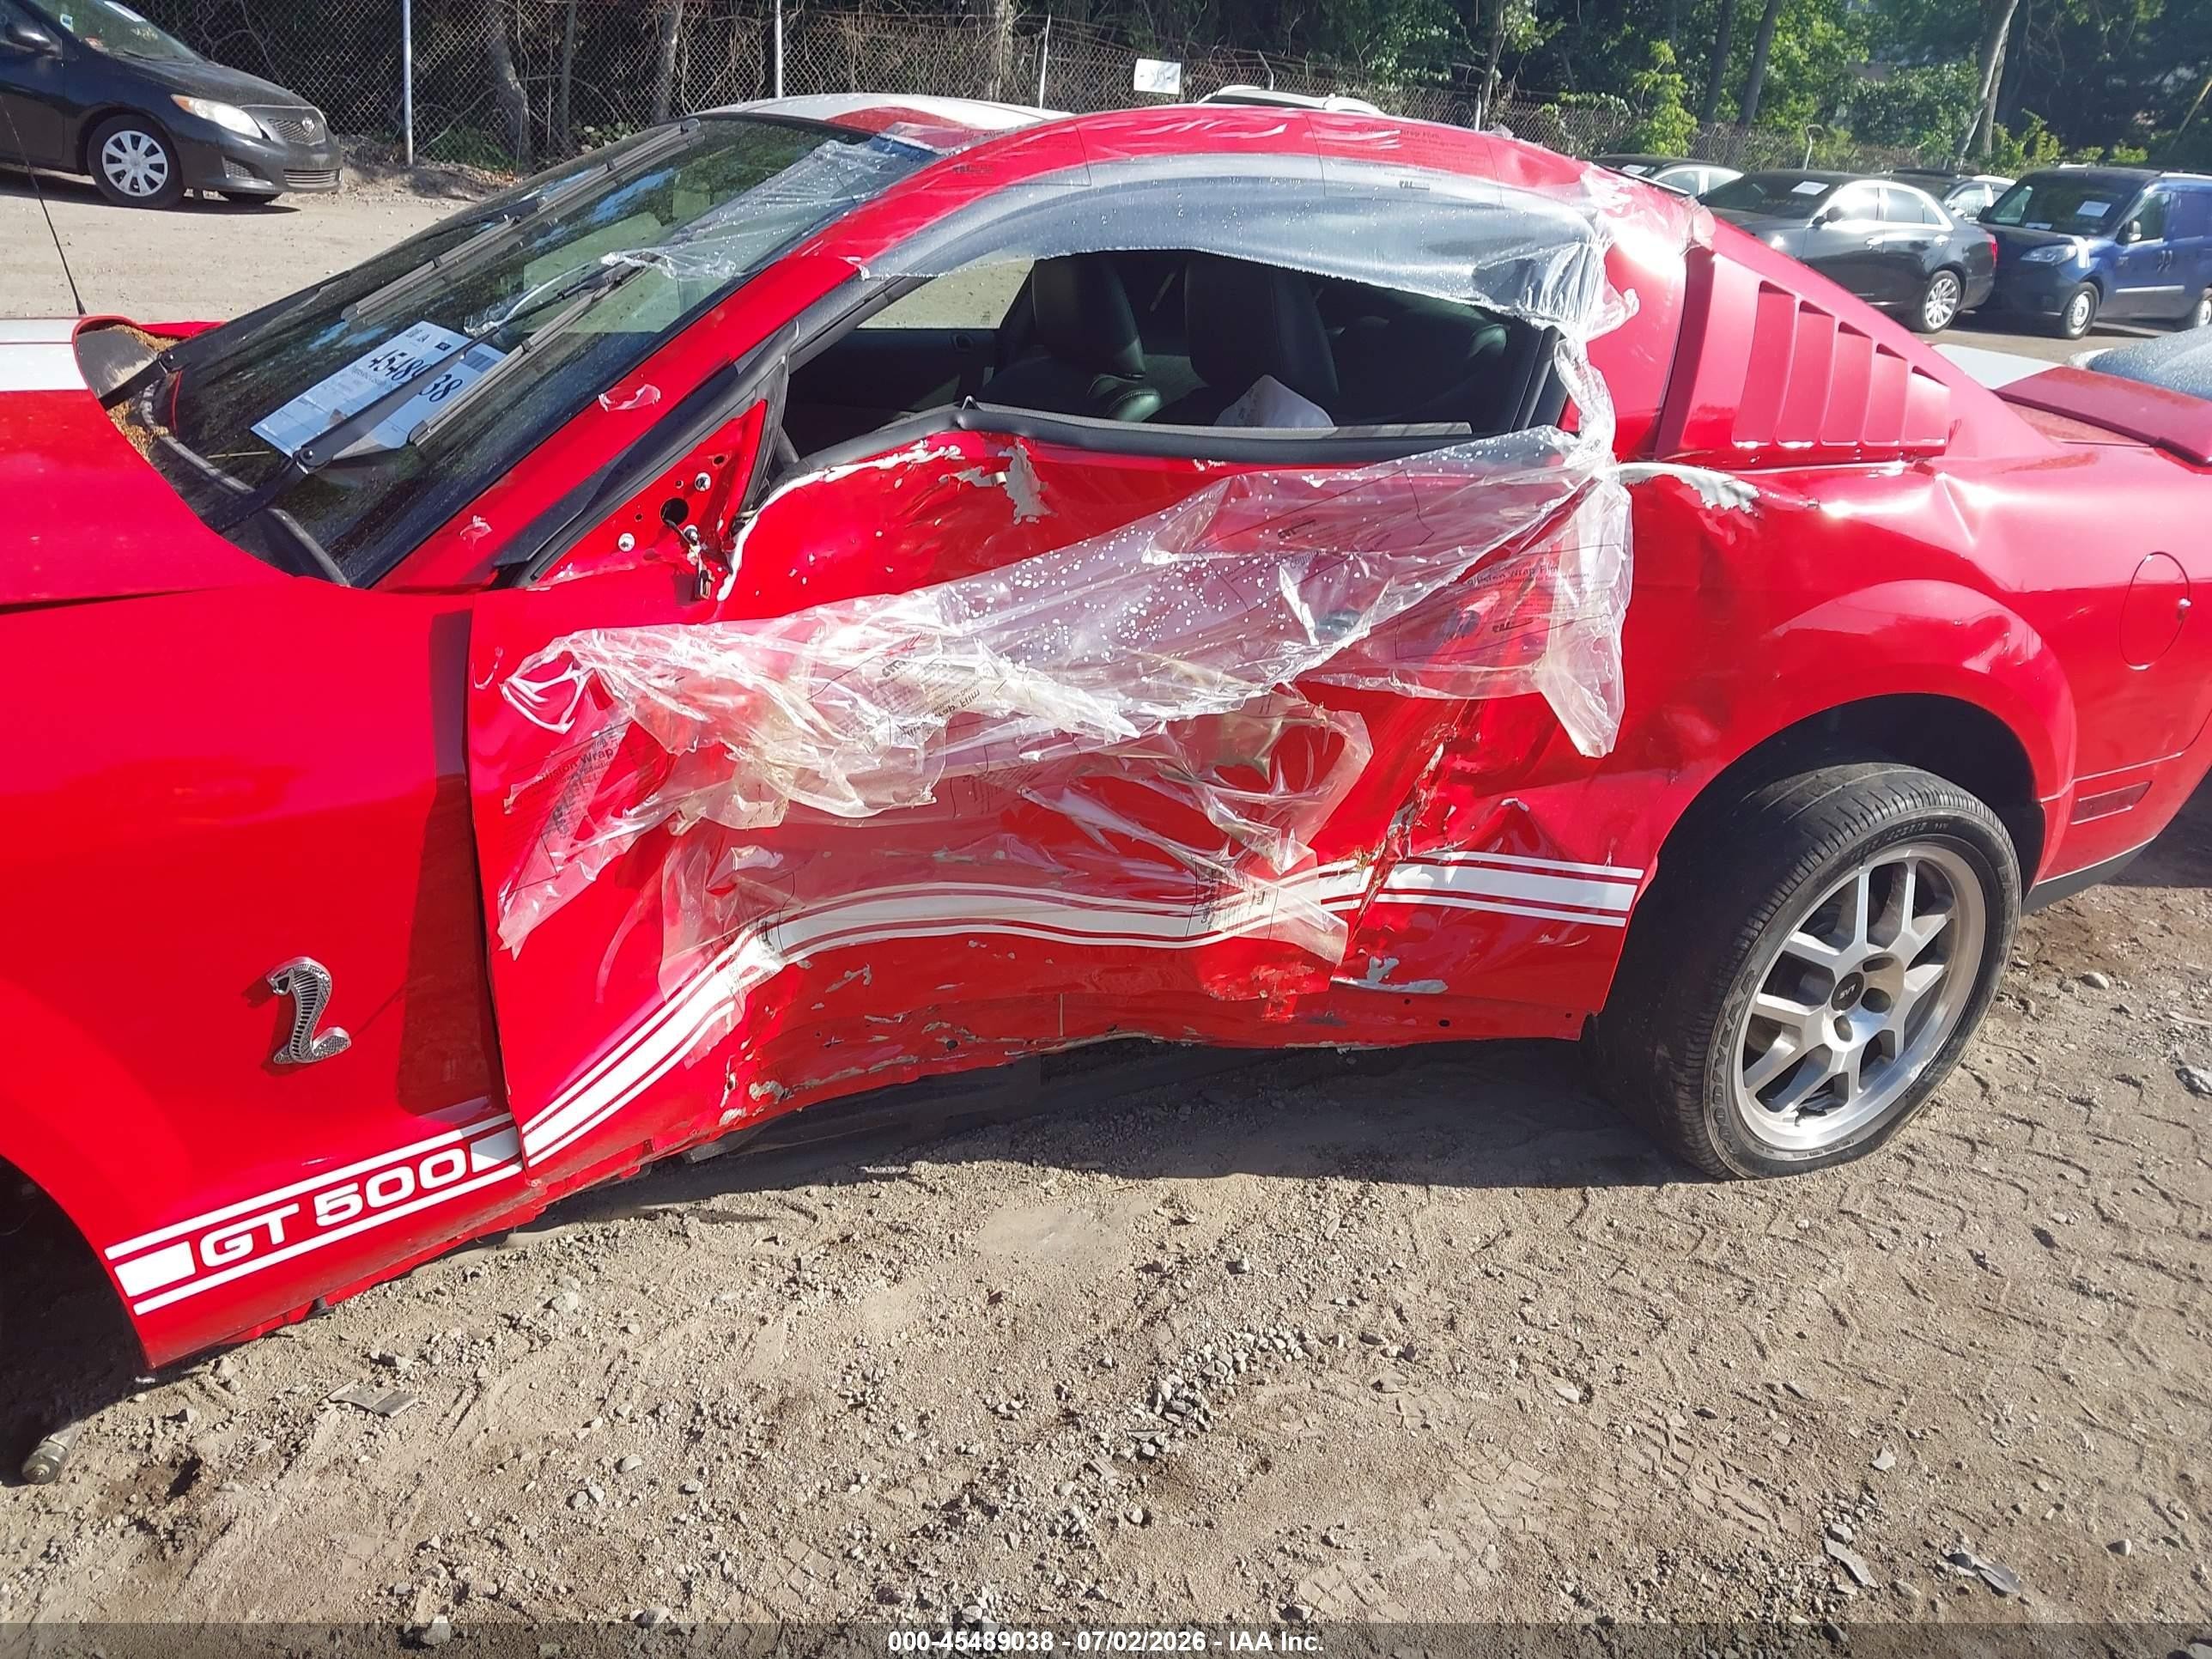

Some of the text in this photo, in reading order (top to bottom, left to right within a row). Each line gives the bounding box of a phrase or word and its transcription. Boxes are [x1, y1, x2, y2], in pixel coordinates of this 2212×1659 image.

[368, 349, 464, 403] 454838
[580, 748, 614, 764] Wrap
[1838, 982, 1856, 1000] SVT
[1711, 969, 1757, 1155] GOODYEAR
[199, 1148, 467, 1267] GT 500
